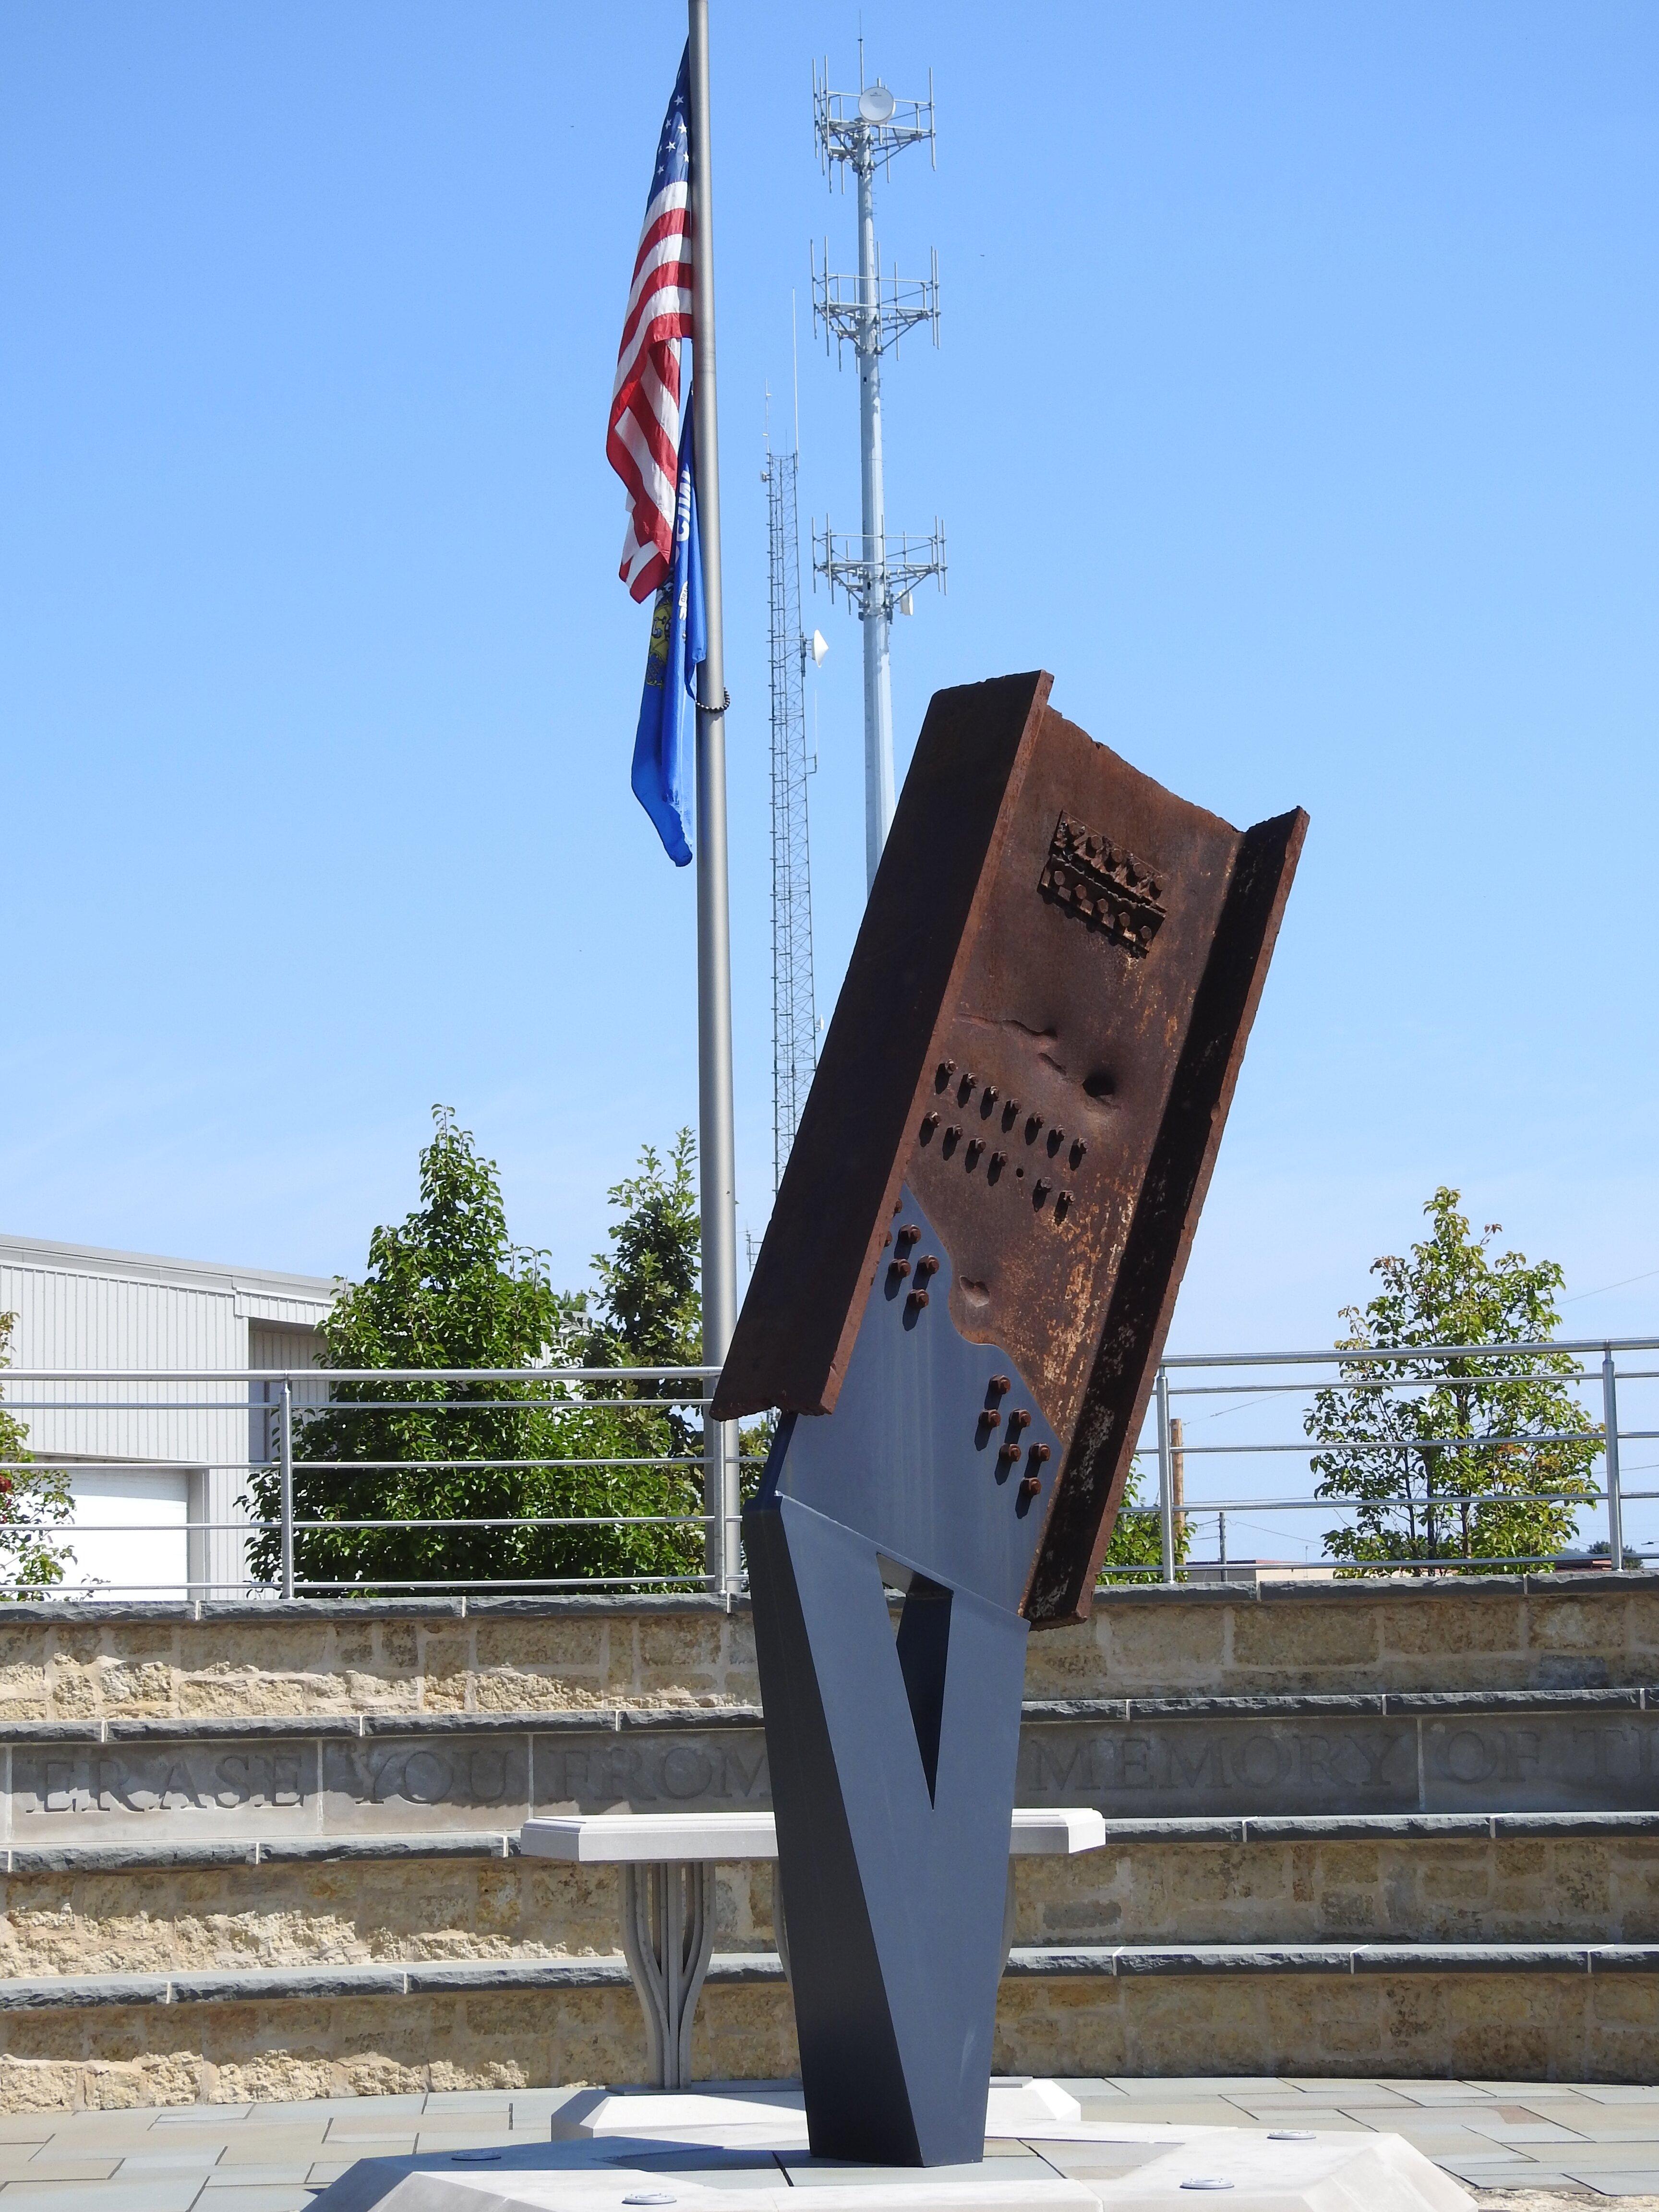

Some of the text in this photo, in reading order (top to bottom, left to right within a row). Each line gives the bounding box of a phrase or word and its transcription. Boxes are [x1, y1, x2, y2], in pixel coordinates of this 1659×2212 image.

[26, 1753, 304, 1813] ERASE
[339, 1748, 515, 1805] YOU
[547, 1744, 772, 1801] FROM
[1028, 1733, 1404, 1790] MEMORY
[1434, 1730, 1541, 1784] OF
